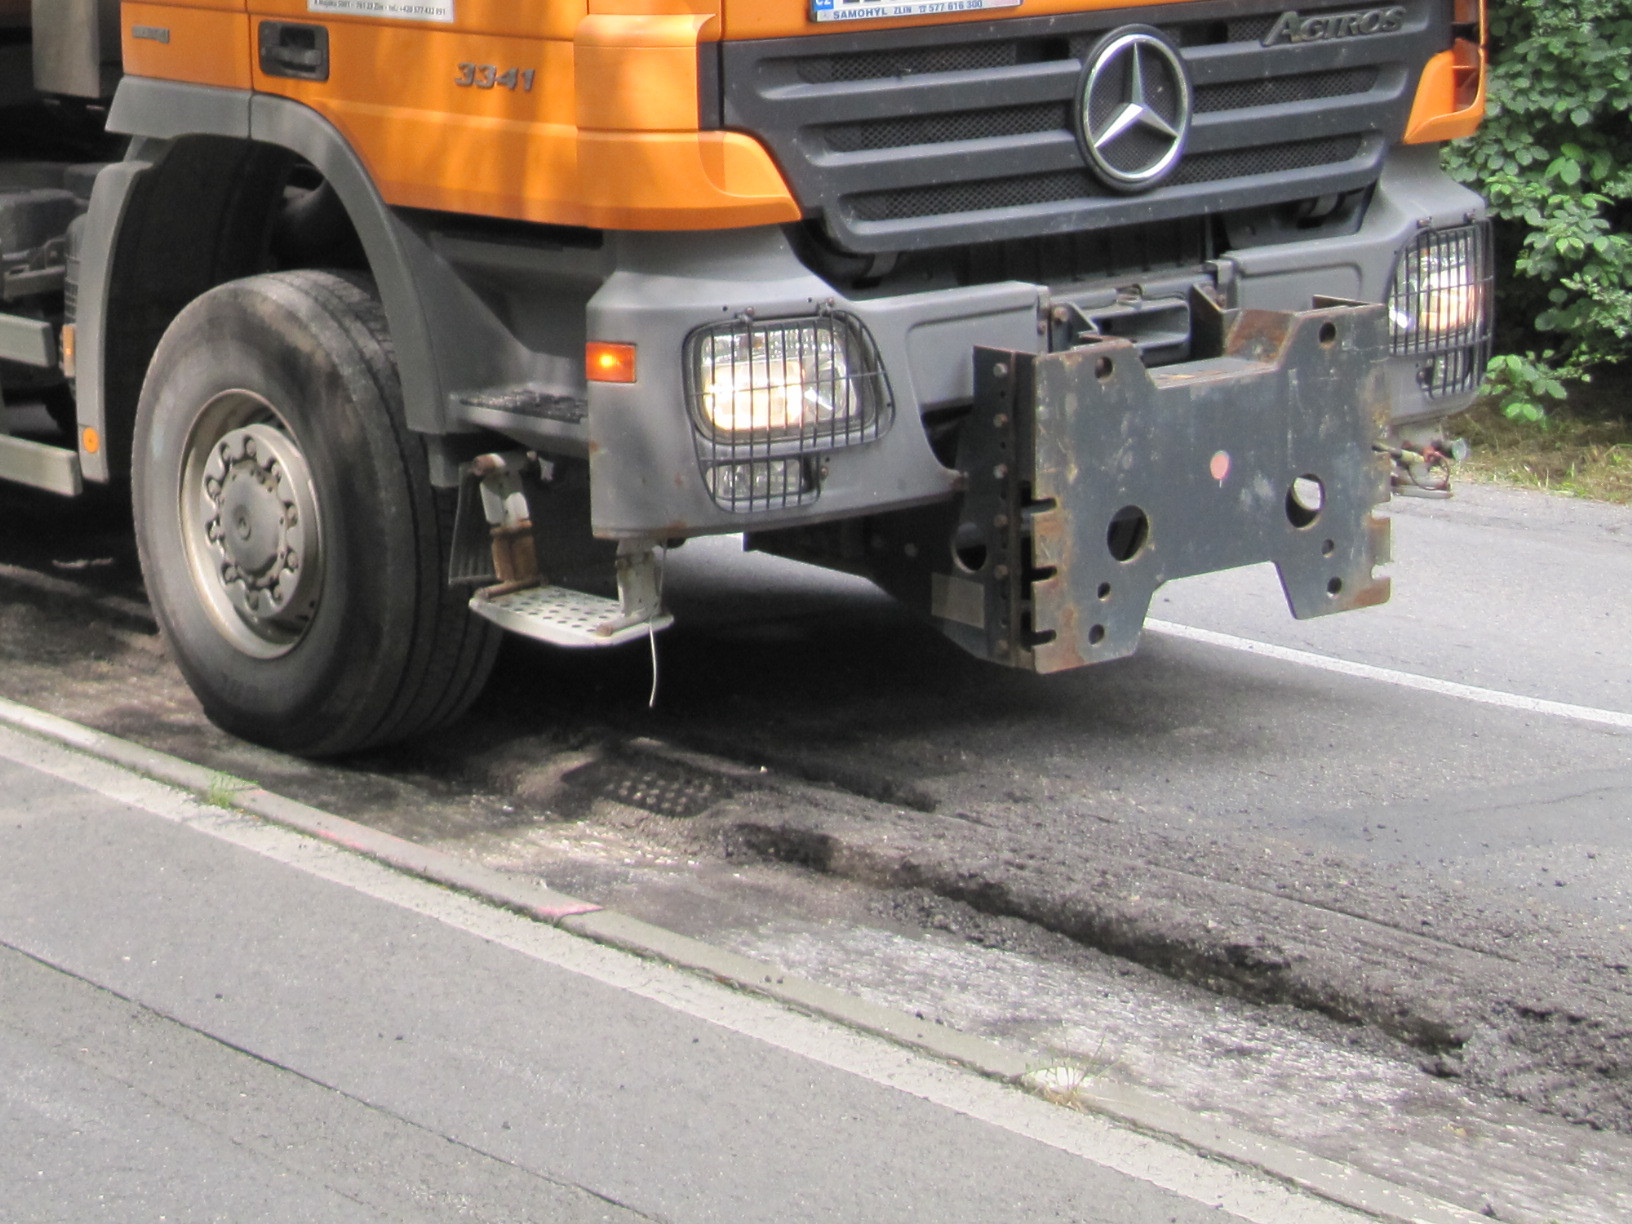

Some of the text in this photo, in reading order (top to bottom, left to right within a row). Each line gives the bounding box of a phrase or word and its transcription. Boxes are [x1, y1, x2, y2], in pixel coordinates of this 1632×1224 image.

[929, 2, 944, 12] 577
[967, 0, 983, 8] 300
[455, 62, 535, 92] 3341
